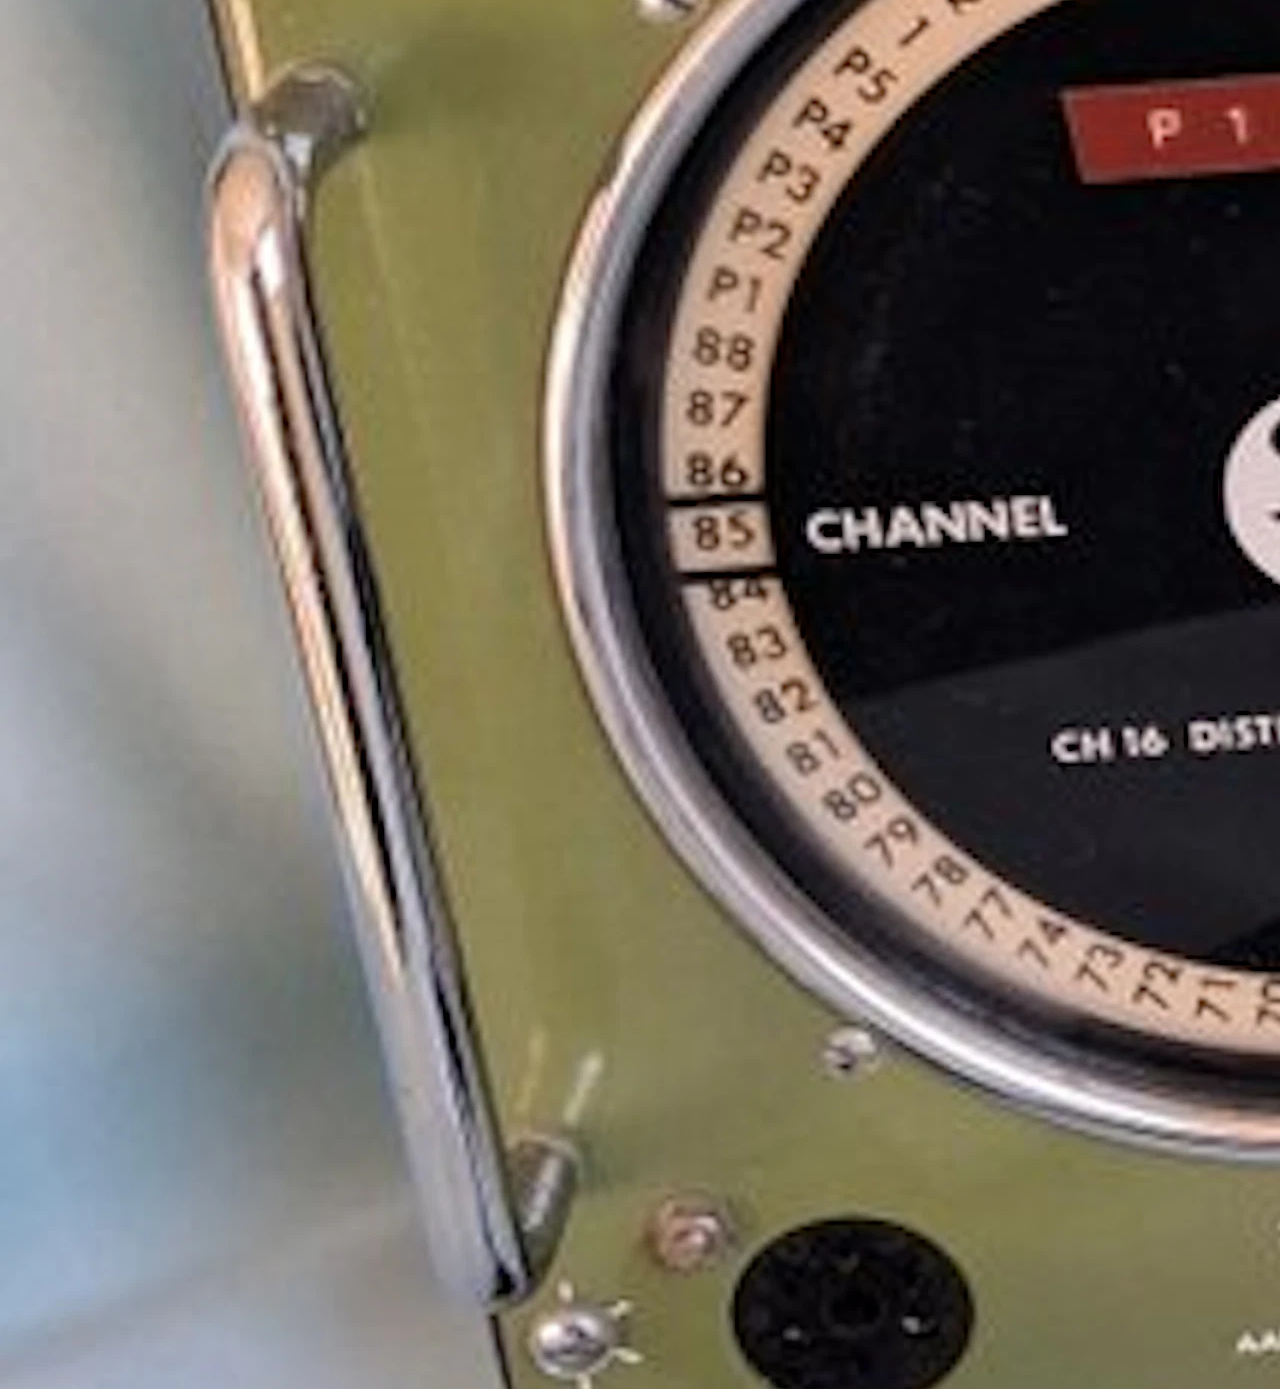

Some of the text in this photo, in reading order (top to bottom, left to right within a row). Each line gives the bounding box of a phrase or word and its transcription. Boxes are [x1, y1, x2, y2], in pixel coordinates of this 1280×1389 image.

[897, 16, 930, 46] 1
[834, 48, 899, 104] P5
[793, 98, 851, 152] P4
[1147, 108, 1183, 149] P
[1228, 107, 1249, 144] 1
[756, 151, 817, 202] P3
[726, 210, 788, 259] P2
[707, 266, 763, 308] P1
[692, 326, 752, 372] 88
[686, 390, 749, 427] 87
[686, 453, 749, 488] 86
[692, 511, 755, 551] 85
[806, 495, 1069, 554] CHANNEL
[727, 624, 788, 670] 83
[753, 679, 817, 724] 82
[786, 729, 843, 774] 81
[1050, 725, 1112, 763] CH
[1123, 722, 1168, 759] 16
[821, 774, 883, 822] 80
[865, 820, 920, 869] 79
[911, 856, 969, 909] 78
[965, 891, 1016, 943] 77
[1016, 918, 1069, 968] 74
[1074, 944, 1125, 994] 73
[1132, 962, 1180, 1010] 72
[1195, 974, 1238, 1022] 71
